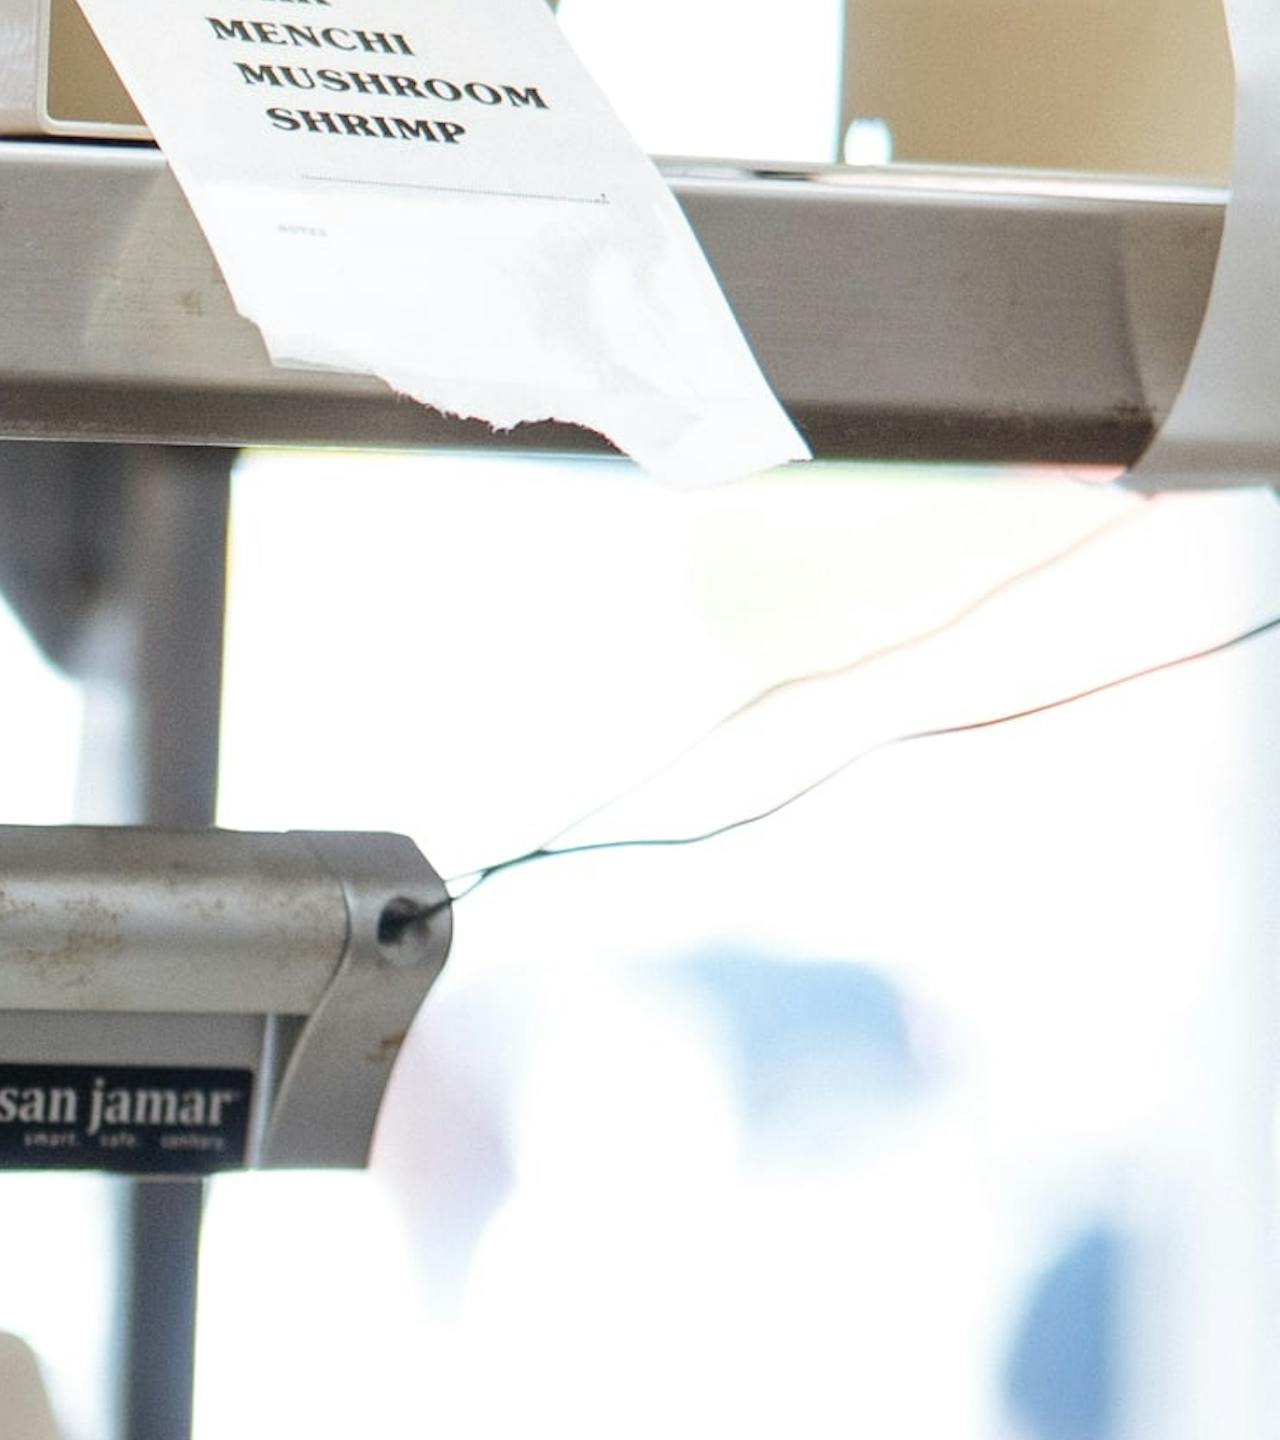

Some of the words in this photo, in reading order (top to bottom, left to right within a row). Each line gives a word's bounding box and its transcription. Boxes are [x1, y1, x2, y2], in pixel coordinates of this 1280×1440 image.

[205, 17, 415, 57] MENCHI
[234, 63, 550, 110] MUSHROOM
[266, 107, 467, 145] SHRIMP
[86, 1078, 233, 1135] jamar
